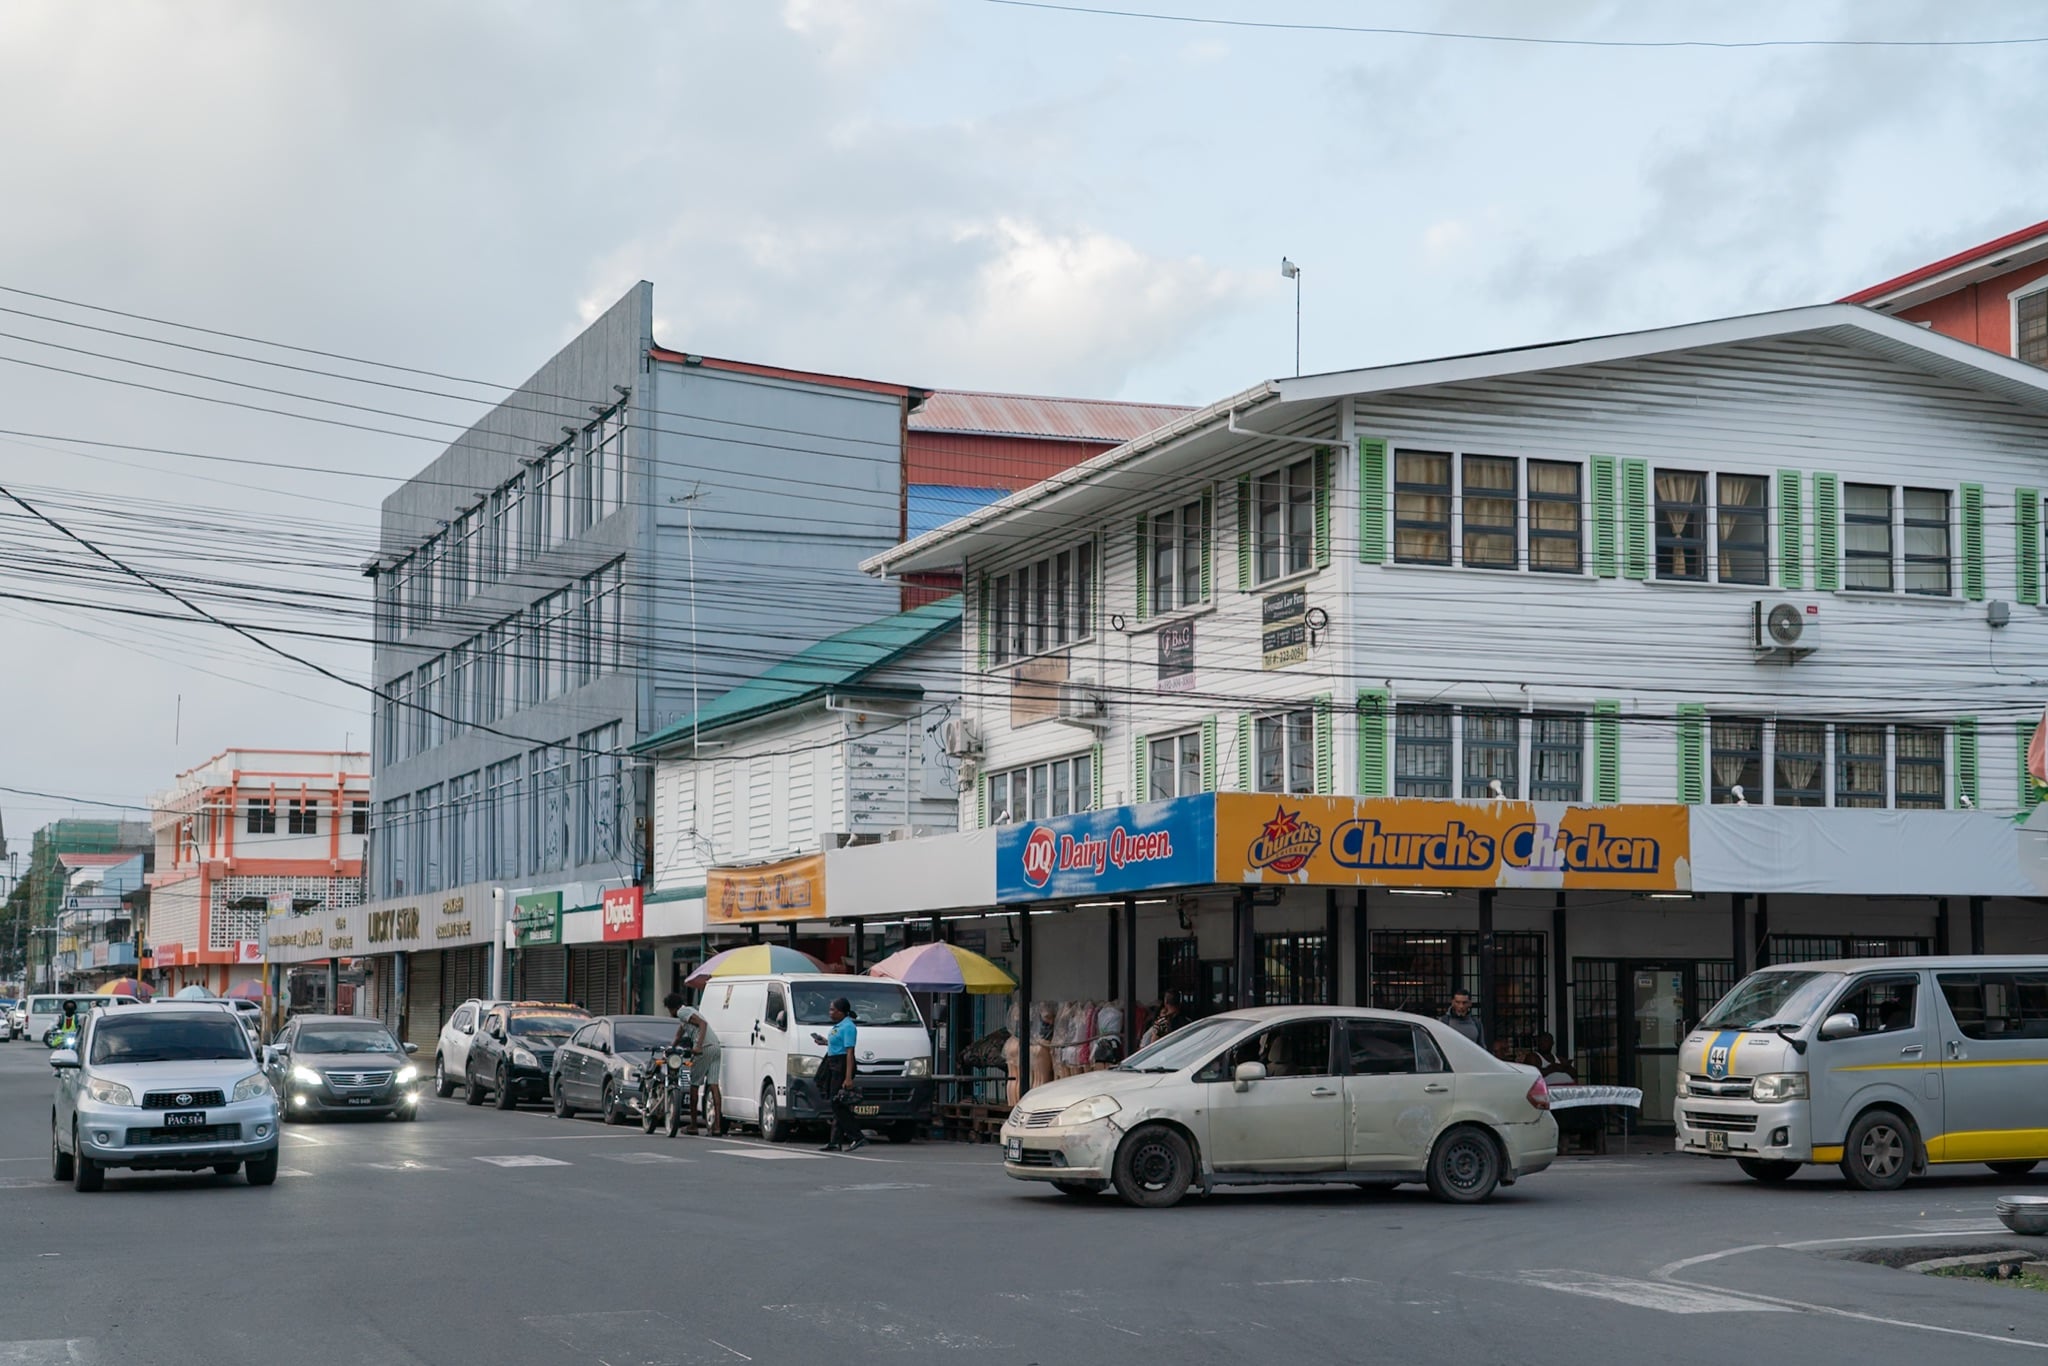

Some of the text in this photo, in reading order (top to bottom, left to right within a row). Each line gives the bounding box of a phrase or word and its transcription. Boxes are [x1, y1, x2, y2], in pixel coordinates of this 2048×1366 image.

[1029, 840, 1051, 873] DQ
[1059, 833, 1107, 875] Dairy
[1248, 822, 1321, 868] Church's
[1330, 819, 1660, 873] Church's Chicken
[368, 910, 395, 943] LUCKY
[396, 907, 420, 940] STAR
[605, 896, 635, 932] Digicel
[1711, 1049, 1725, 1064] 44
[168, 1115, 203, 1125] PAC 514
